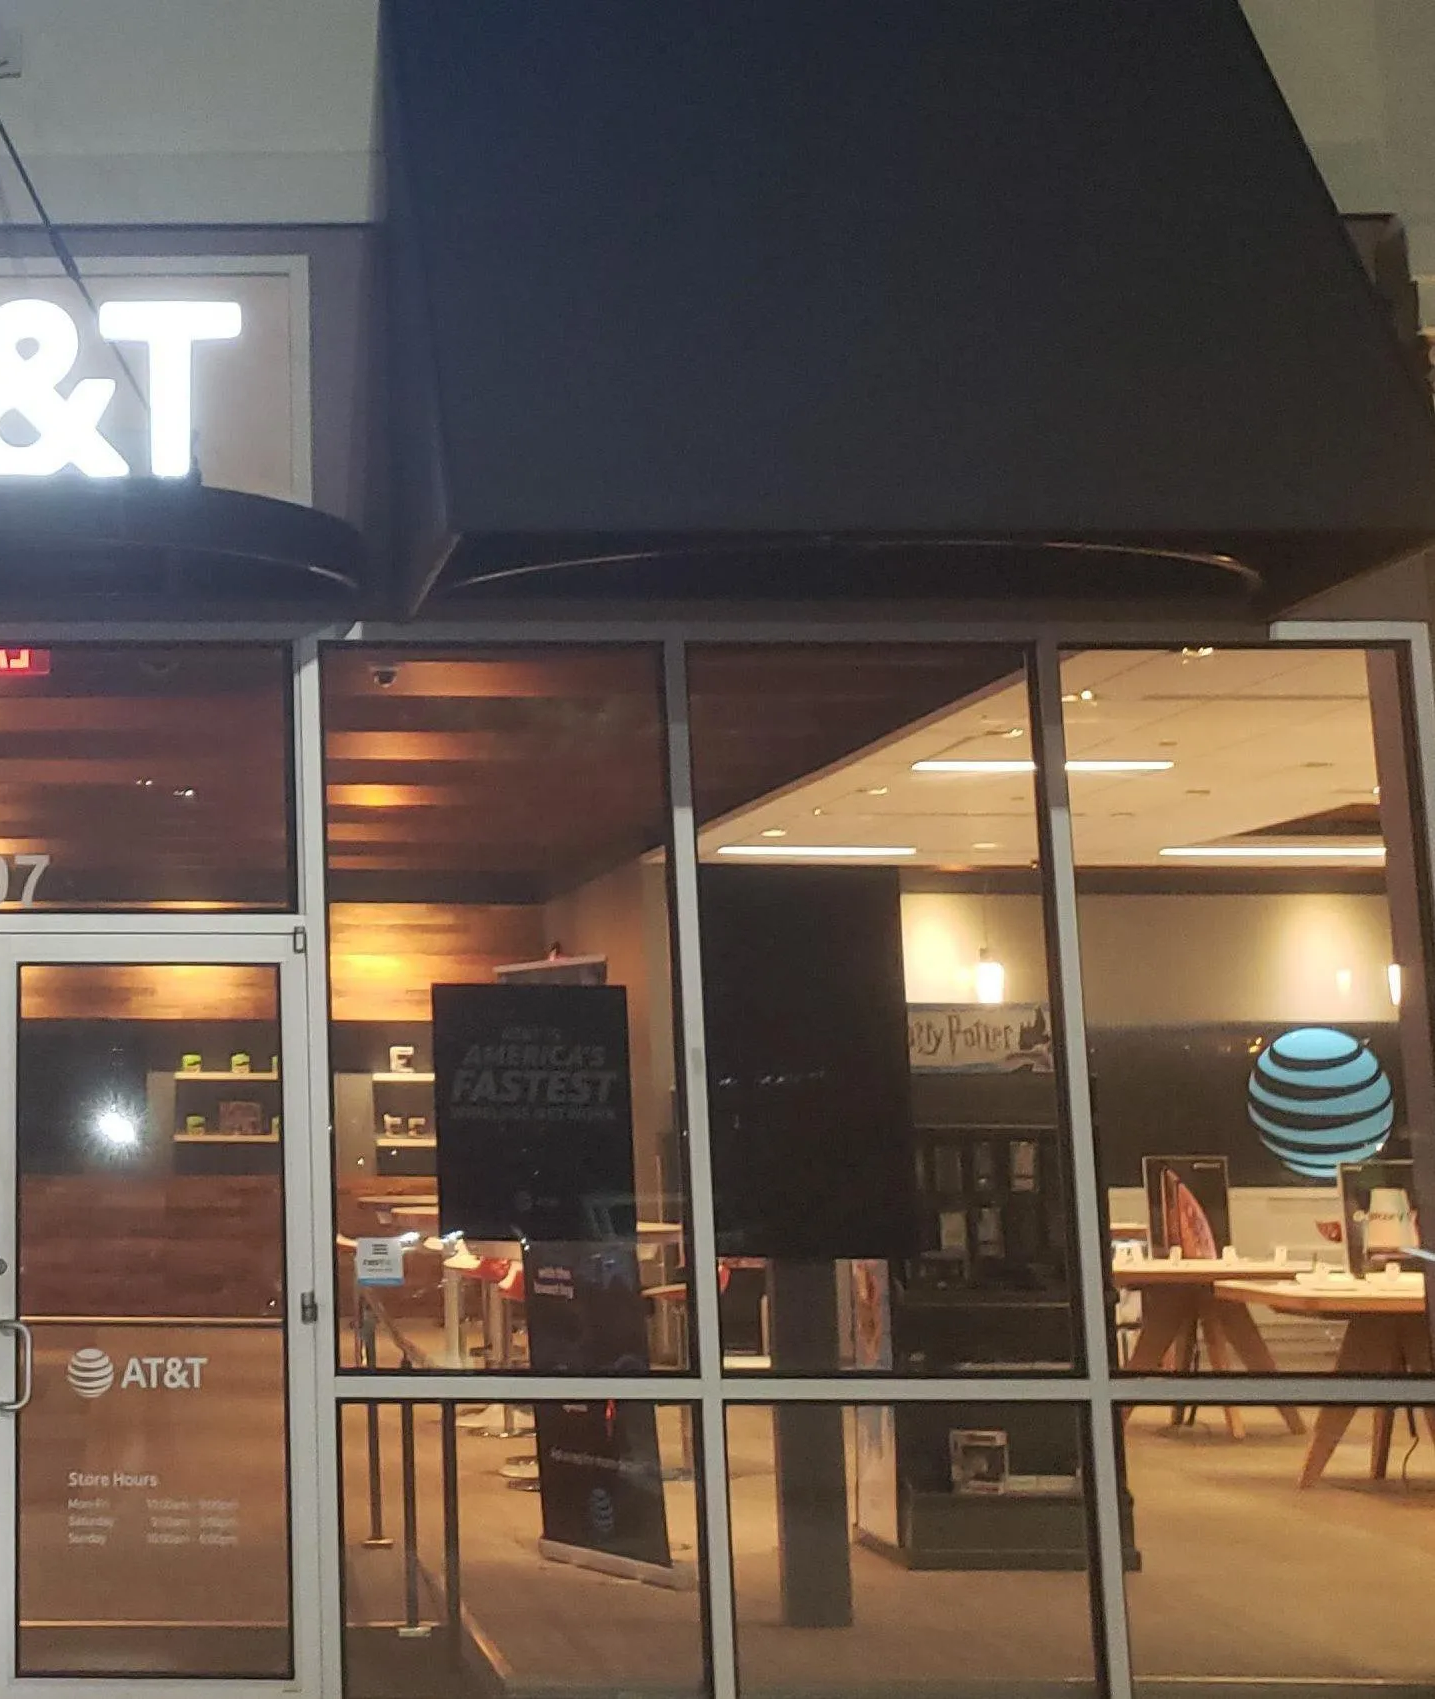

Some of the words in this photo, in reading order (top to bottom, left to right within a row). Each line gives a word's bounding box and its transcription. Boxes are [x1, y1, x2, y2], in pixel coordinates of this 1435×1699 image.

[948, 1014, 1014, 1057] Potter
[461, 1043, 606, 1067] AMERICA'S
[450, 1069, 618, 1103] FASTEST
[120, 1356, 208, 1389] AT&T
[68, 1472, 110, 1487] Store
[113, 1472, 157, 1487] Hours
